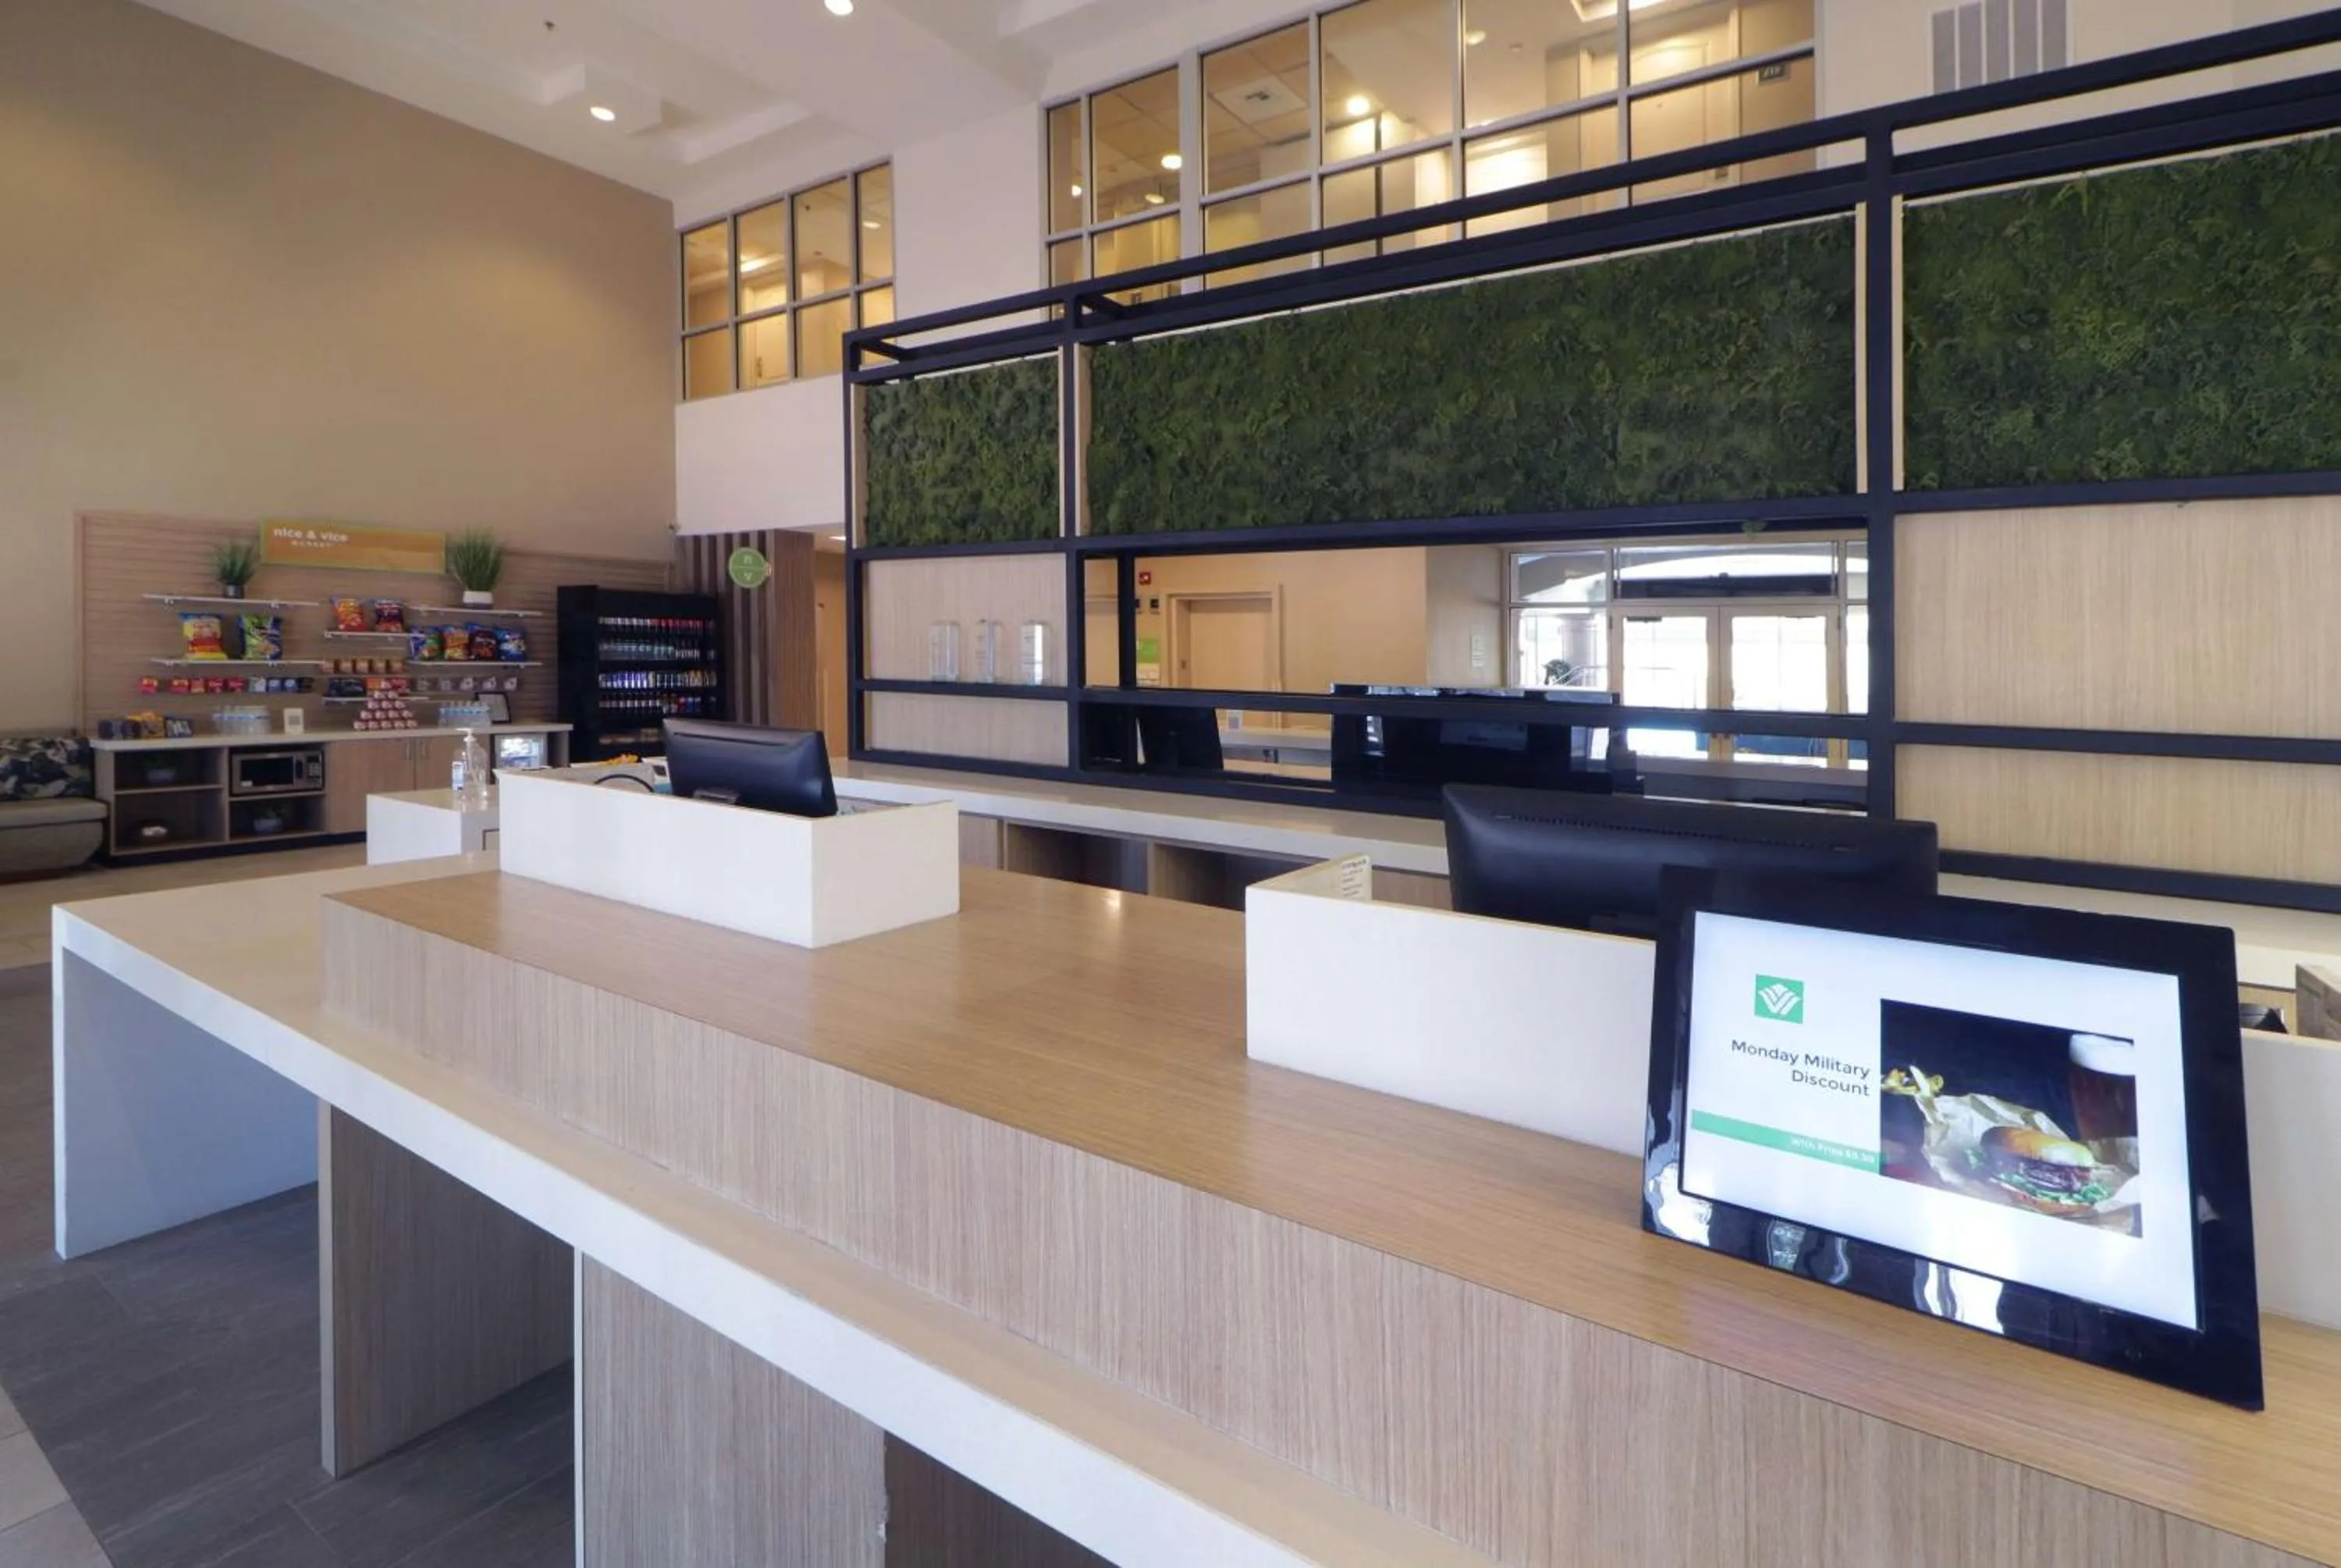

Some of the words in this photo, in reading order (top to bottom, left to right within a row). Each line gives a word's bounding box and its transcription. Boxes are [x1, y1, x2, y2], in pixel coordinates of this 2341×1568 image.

[273, 528, 303, 539] nice
[320, 531, 348, 543] vice
[1731, 1039, 1799, 1066] Monday
[1804, 1053, 1870, 1080] Military
[1792, 1070, 1870, 1096] Discount
